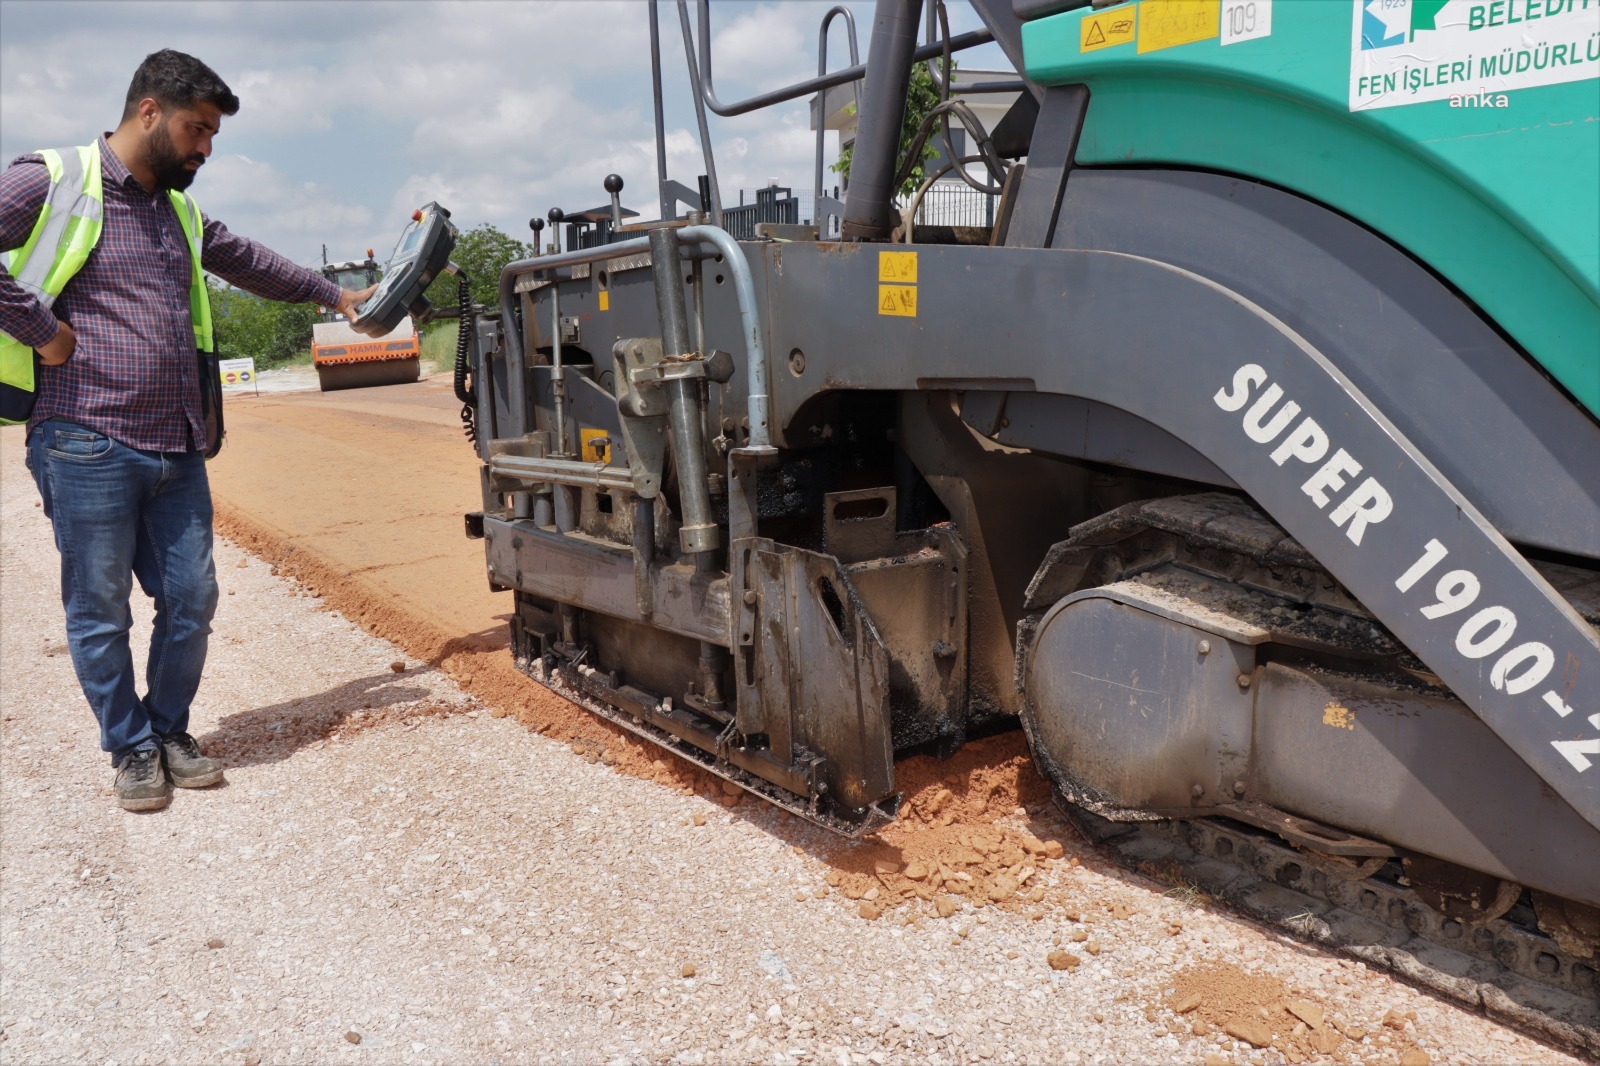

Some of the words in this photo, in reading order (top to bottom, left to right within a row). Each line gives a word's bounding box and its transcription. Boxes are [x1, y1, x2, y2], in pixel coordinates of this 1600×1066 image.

[1227, 2, 1257, 37] 109
[1358, 72, 1396, 96] FEN
[1403, 54, 1473, 94] İŞLERİ
[350, 344, 383, 354] HAMM
[1213, 363, 1394, 547] SUPER
[1394, 538, 1600, 773] 1900-2
